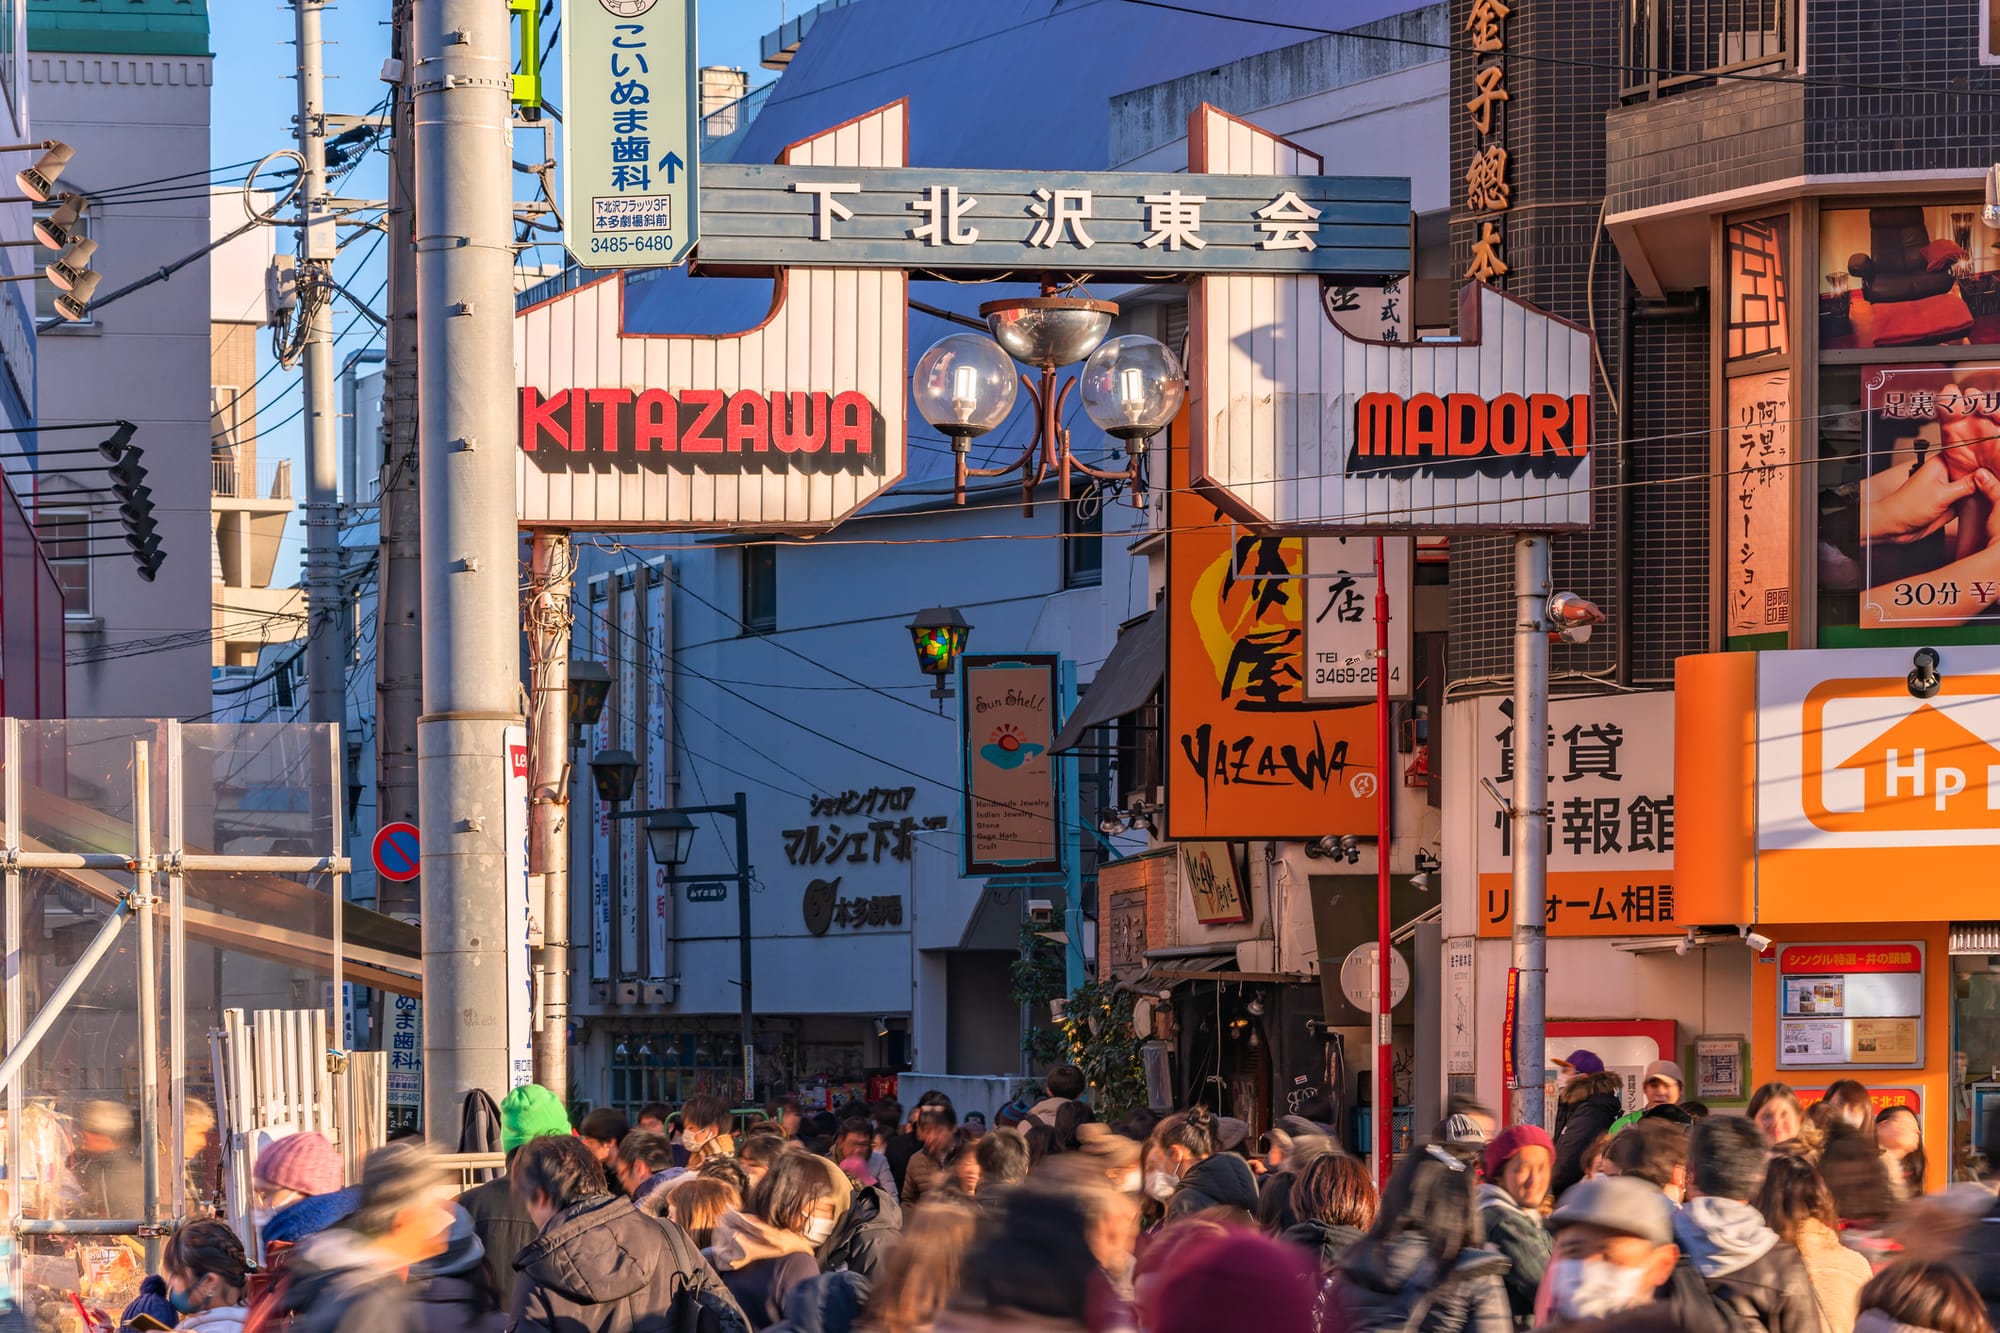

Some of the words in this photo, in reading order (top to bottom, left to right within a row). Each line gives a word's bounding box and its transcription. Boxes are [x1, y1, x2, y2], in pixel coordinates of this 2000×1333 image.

[610, 24, 651, 192] こいぬま歯科
[595, 199, 668, 213] 下北沢フラッツ3F
[795, 182, 1322, 252] 下北沢東会
[595, 214, 668, 229] 本多劇場斜前
[590, 235, 673, 253] 3485-6480
[523, 386, 872, 454] KITAZAWA
[1357, 392, 1588, 457] MADORI
[1894, 582, 1961, 606] 30分
[1315, 666, 1400, 684] 3469-284
[976, 697, 1002, 713] Sun
[1005, 689, 1046, 712] Shell
[1181, 720, 1377, 832] YAZAWA
